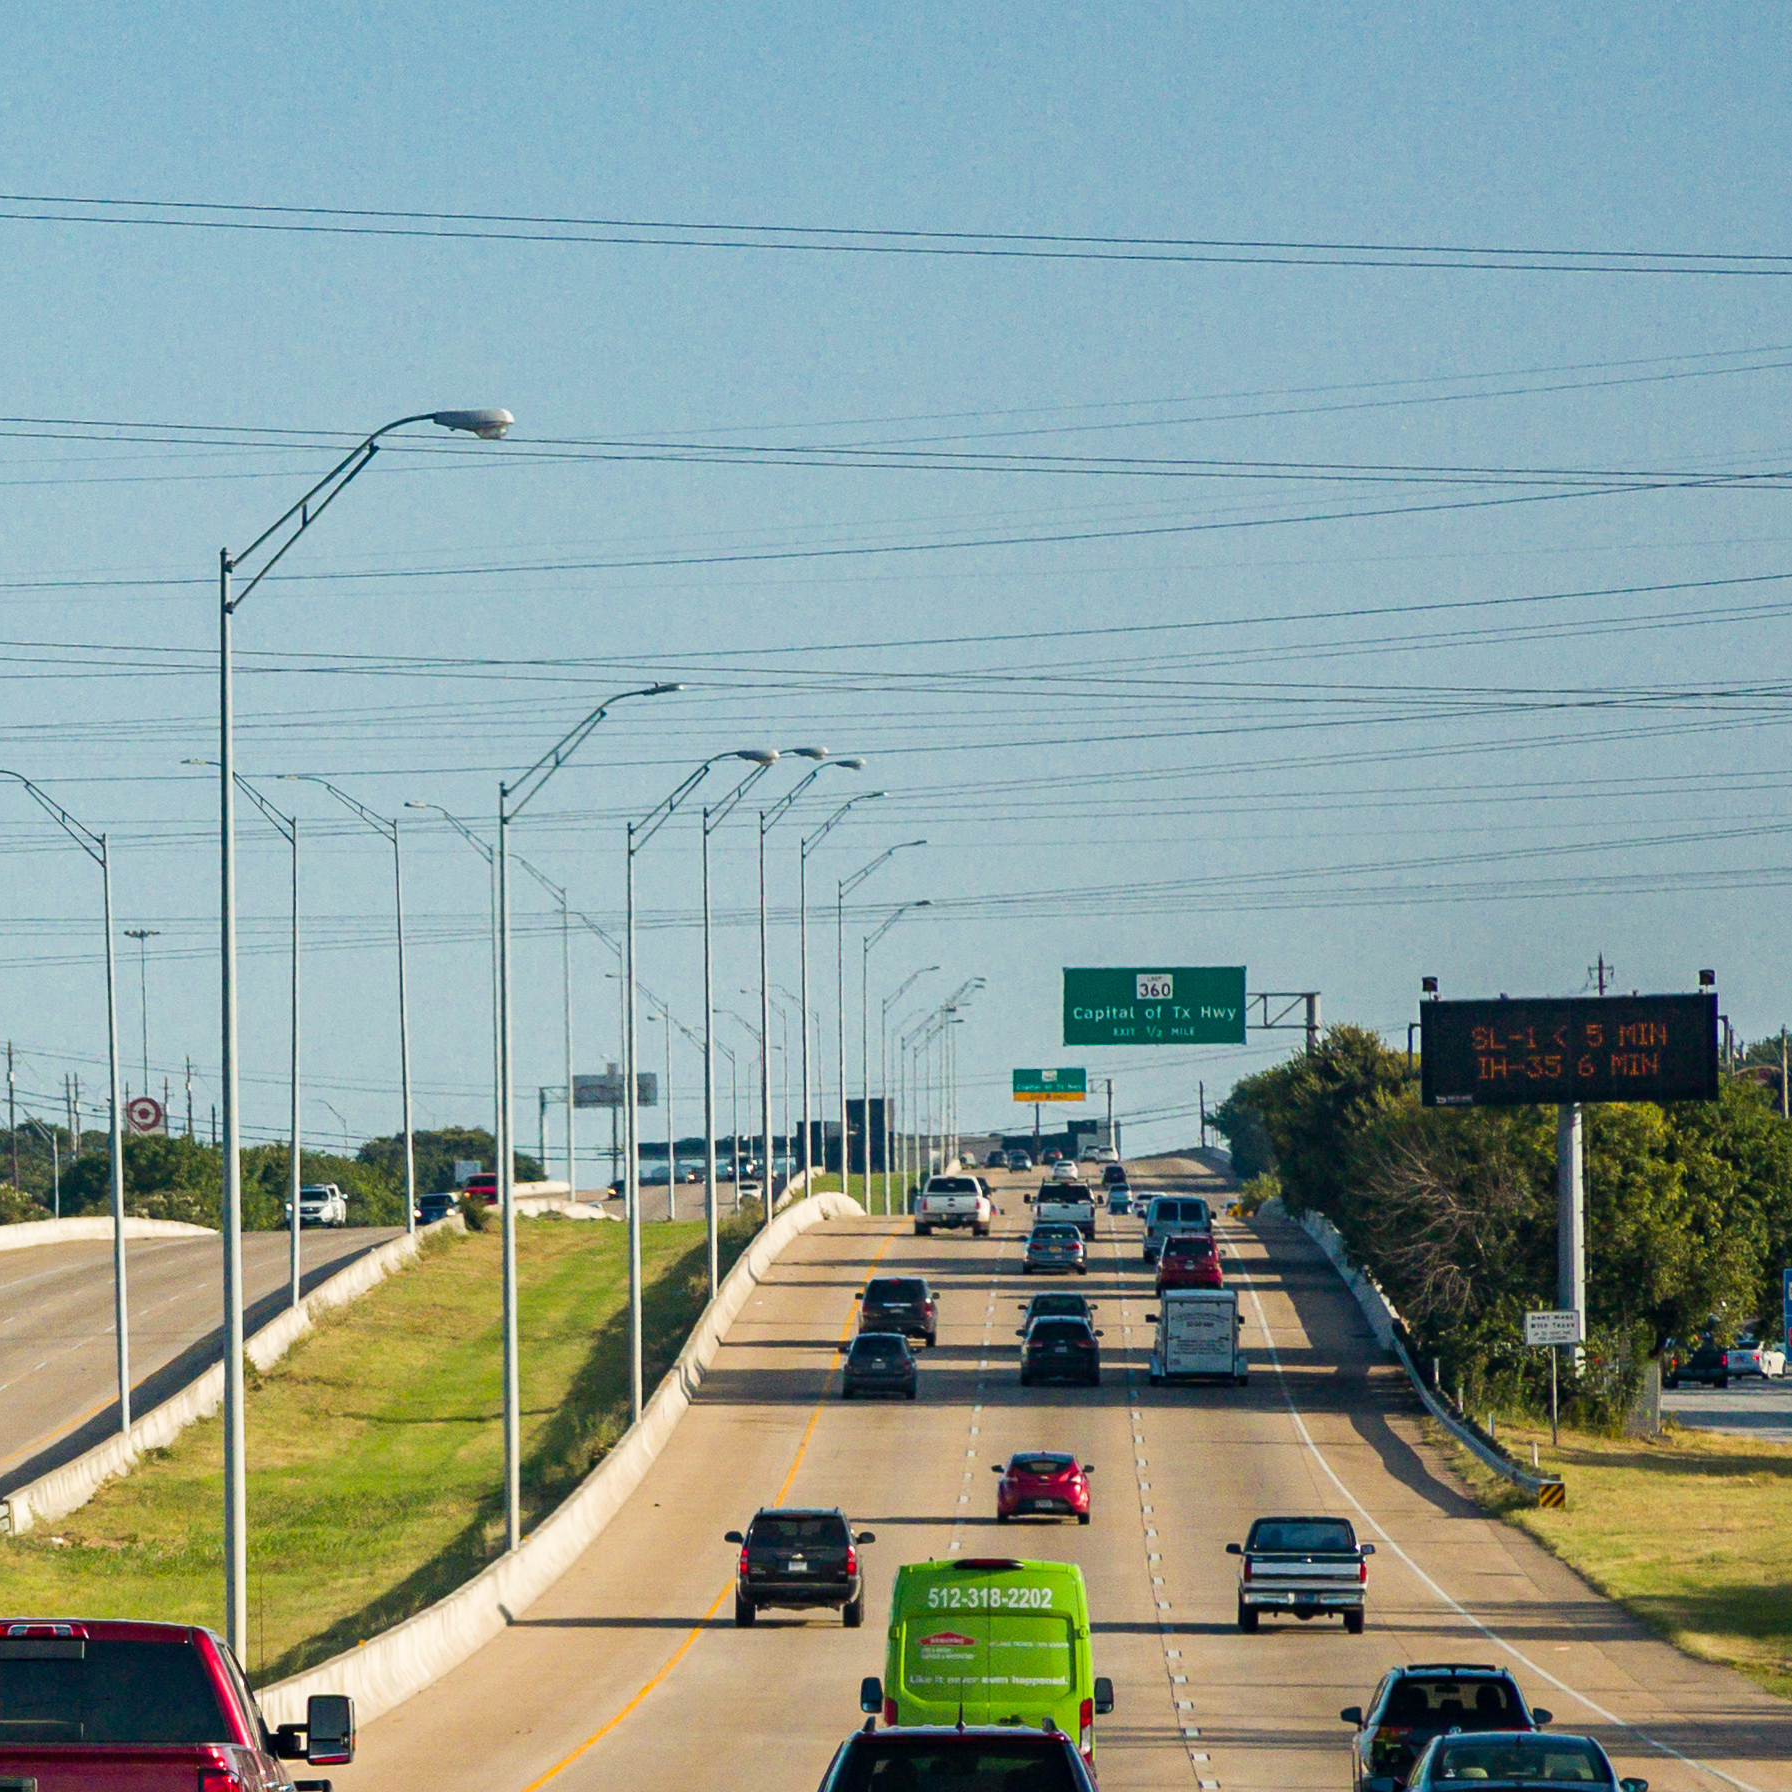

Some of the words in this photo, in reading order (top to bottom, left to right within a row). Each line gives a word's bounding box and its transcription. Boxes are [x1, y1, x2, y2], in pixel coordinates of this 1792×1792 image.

[1139, 983, 1171, 997] 360
[1073, 1006, 1135, 1022] Capital
[1145, 1005, 1162, 1019] of
[1172, 1006, 1191, 1019] Tx
[1201, 1005, 1237, 1021] Hwy
[1113, 1027, 1135, 1036] EXIT
[1171, 1027, 1195, 1036] MILE
[1471, 1026, 1536, 1049] SL-1
[1586, 1024, 1603, 1047] 5
[1619, 1022, 1668, 1047] MIN
[1478, 1054, 1562, 1079] IH-35
[1578, 1053, 1595, 1077] 6
[1611, 1052, 1658, 1076] MIN
[928, 1588, 1052, 1608] 512-318-2202
[982, 1676, 1008, 1684] even
